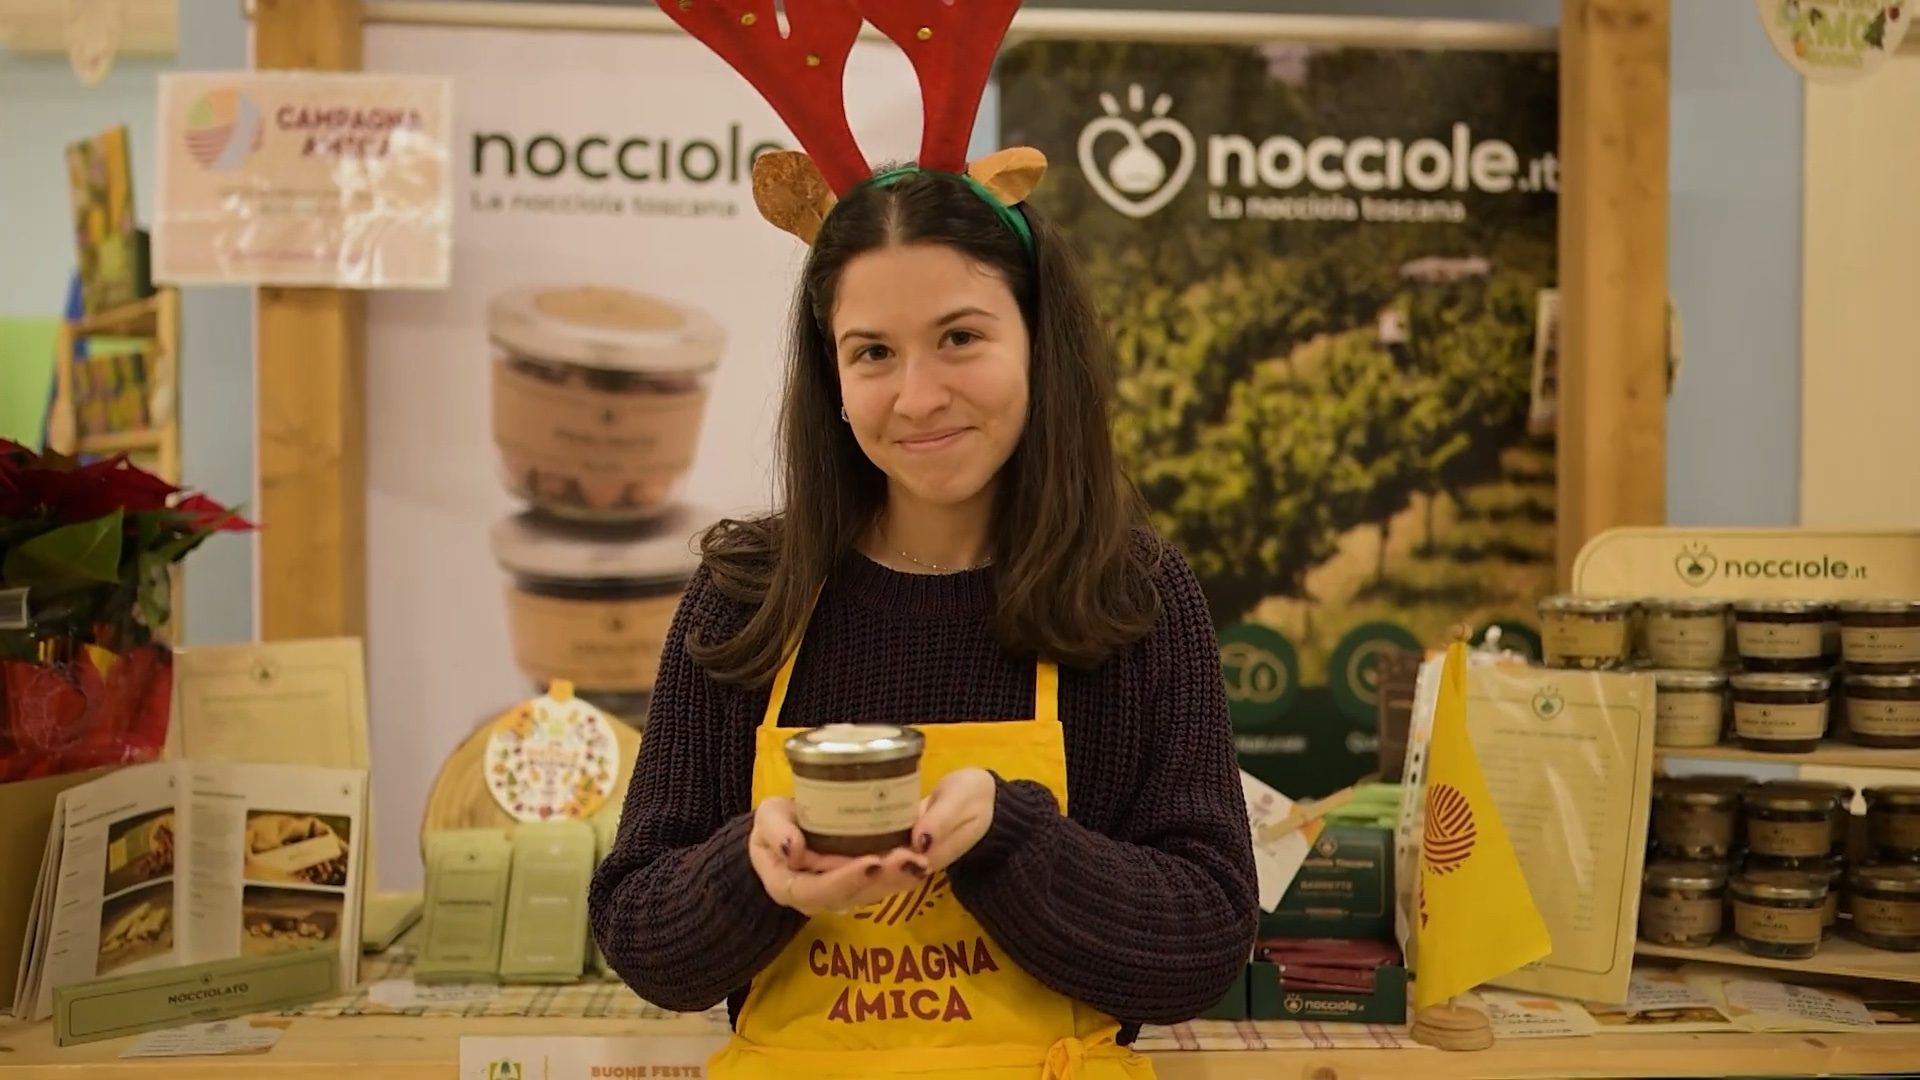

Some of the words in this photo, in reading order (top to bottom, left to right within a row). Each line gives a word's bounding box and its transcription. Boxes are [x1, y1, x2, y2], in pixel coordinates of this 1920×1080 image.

[1207, 121, 1560, 194] nocciole.it
[1208, 195, 1243, 219] La
[1245, 193, 1360, 222] nocciola
[1361, 197, 1467, 224] toscana
[1724, 555, 1867, 579] nocciole.it
[808, 936, 999, 984] CAMPAGNA
[167, 982, 249, 1005] NOCCIOLATO
[827, 984, 973, 1024] AMICA
[591, 1065, 646, 1079] BUONE
[652, 1065, 701, 1079] FESTE
